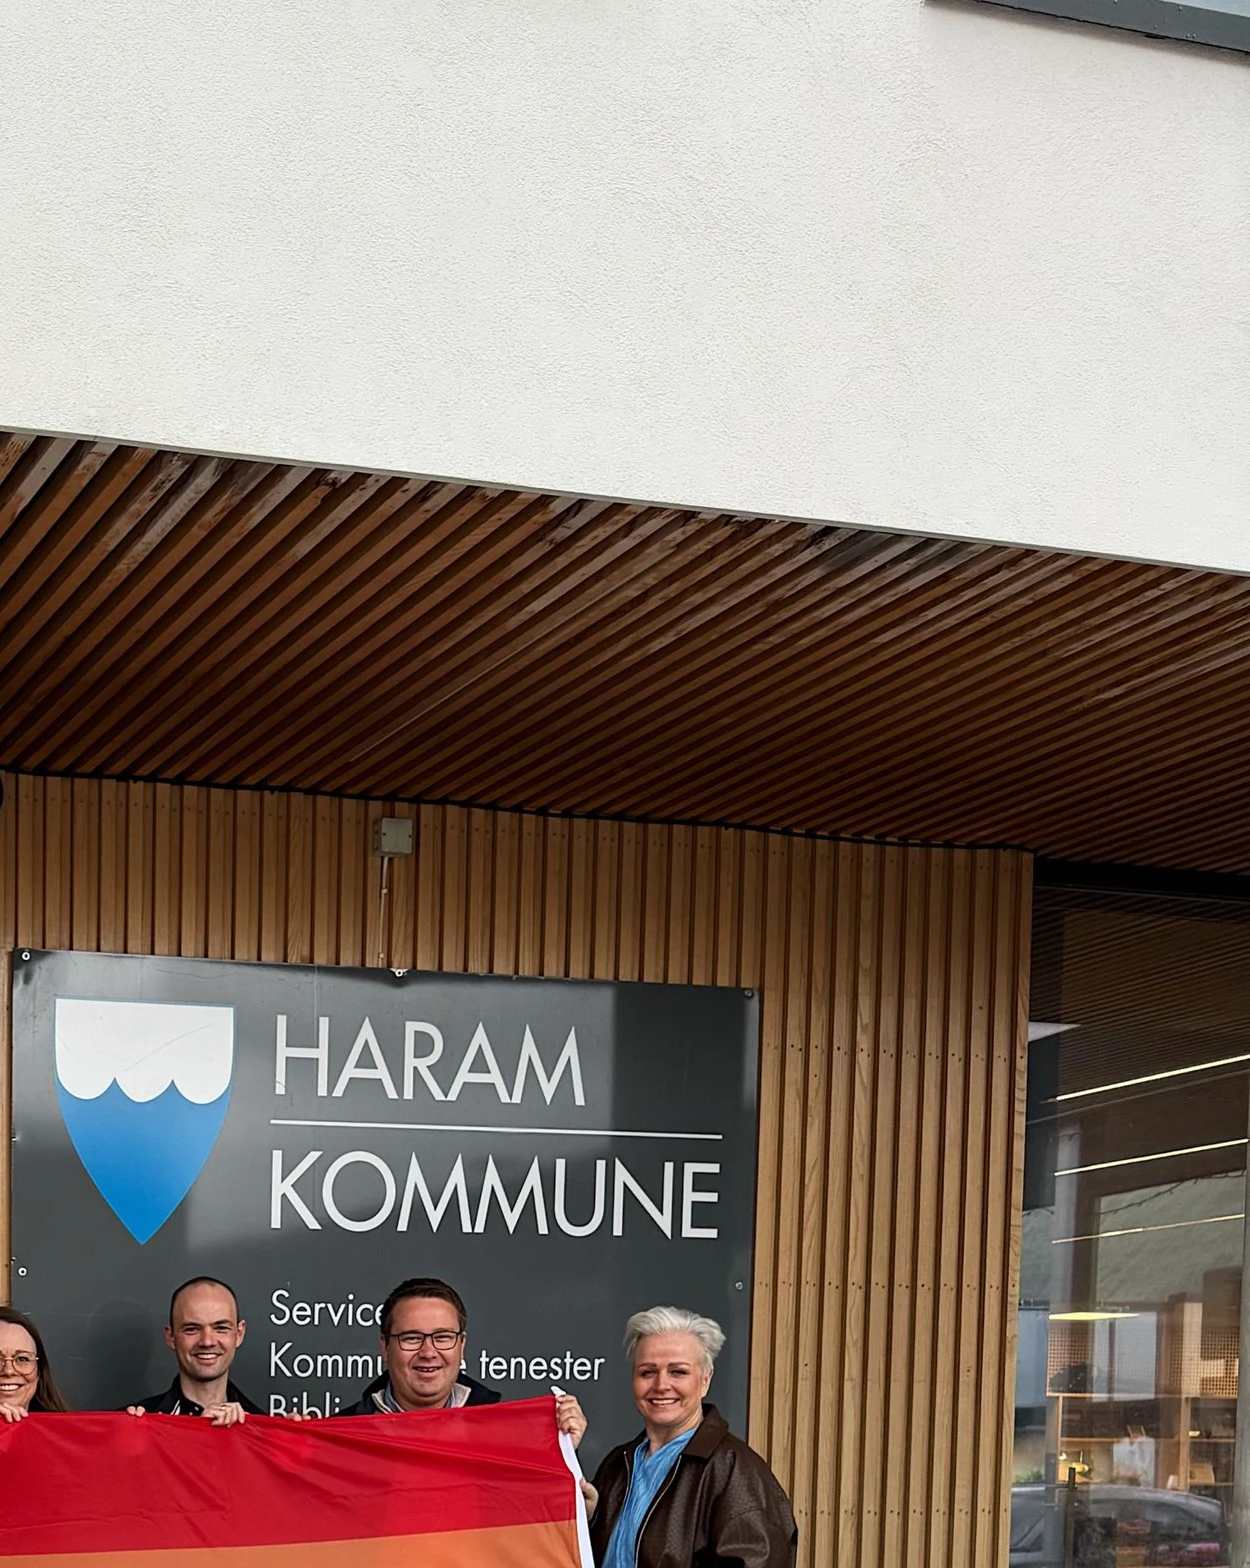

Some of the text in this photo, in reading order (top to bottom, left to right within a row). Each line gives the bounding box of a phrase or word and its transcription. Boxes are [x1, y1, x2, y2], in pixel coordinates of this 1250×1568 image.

[274, 1012, 586, 1107] HARAM
[269, 1149, 721, 1241] KOMMUNE
[479, 1350, 606, 1381] tenester
